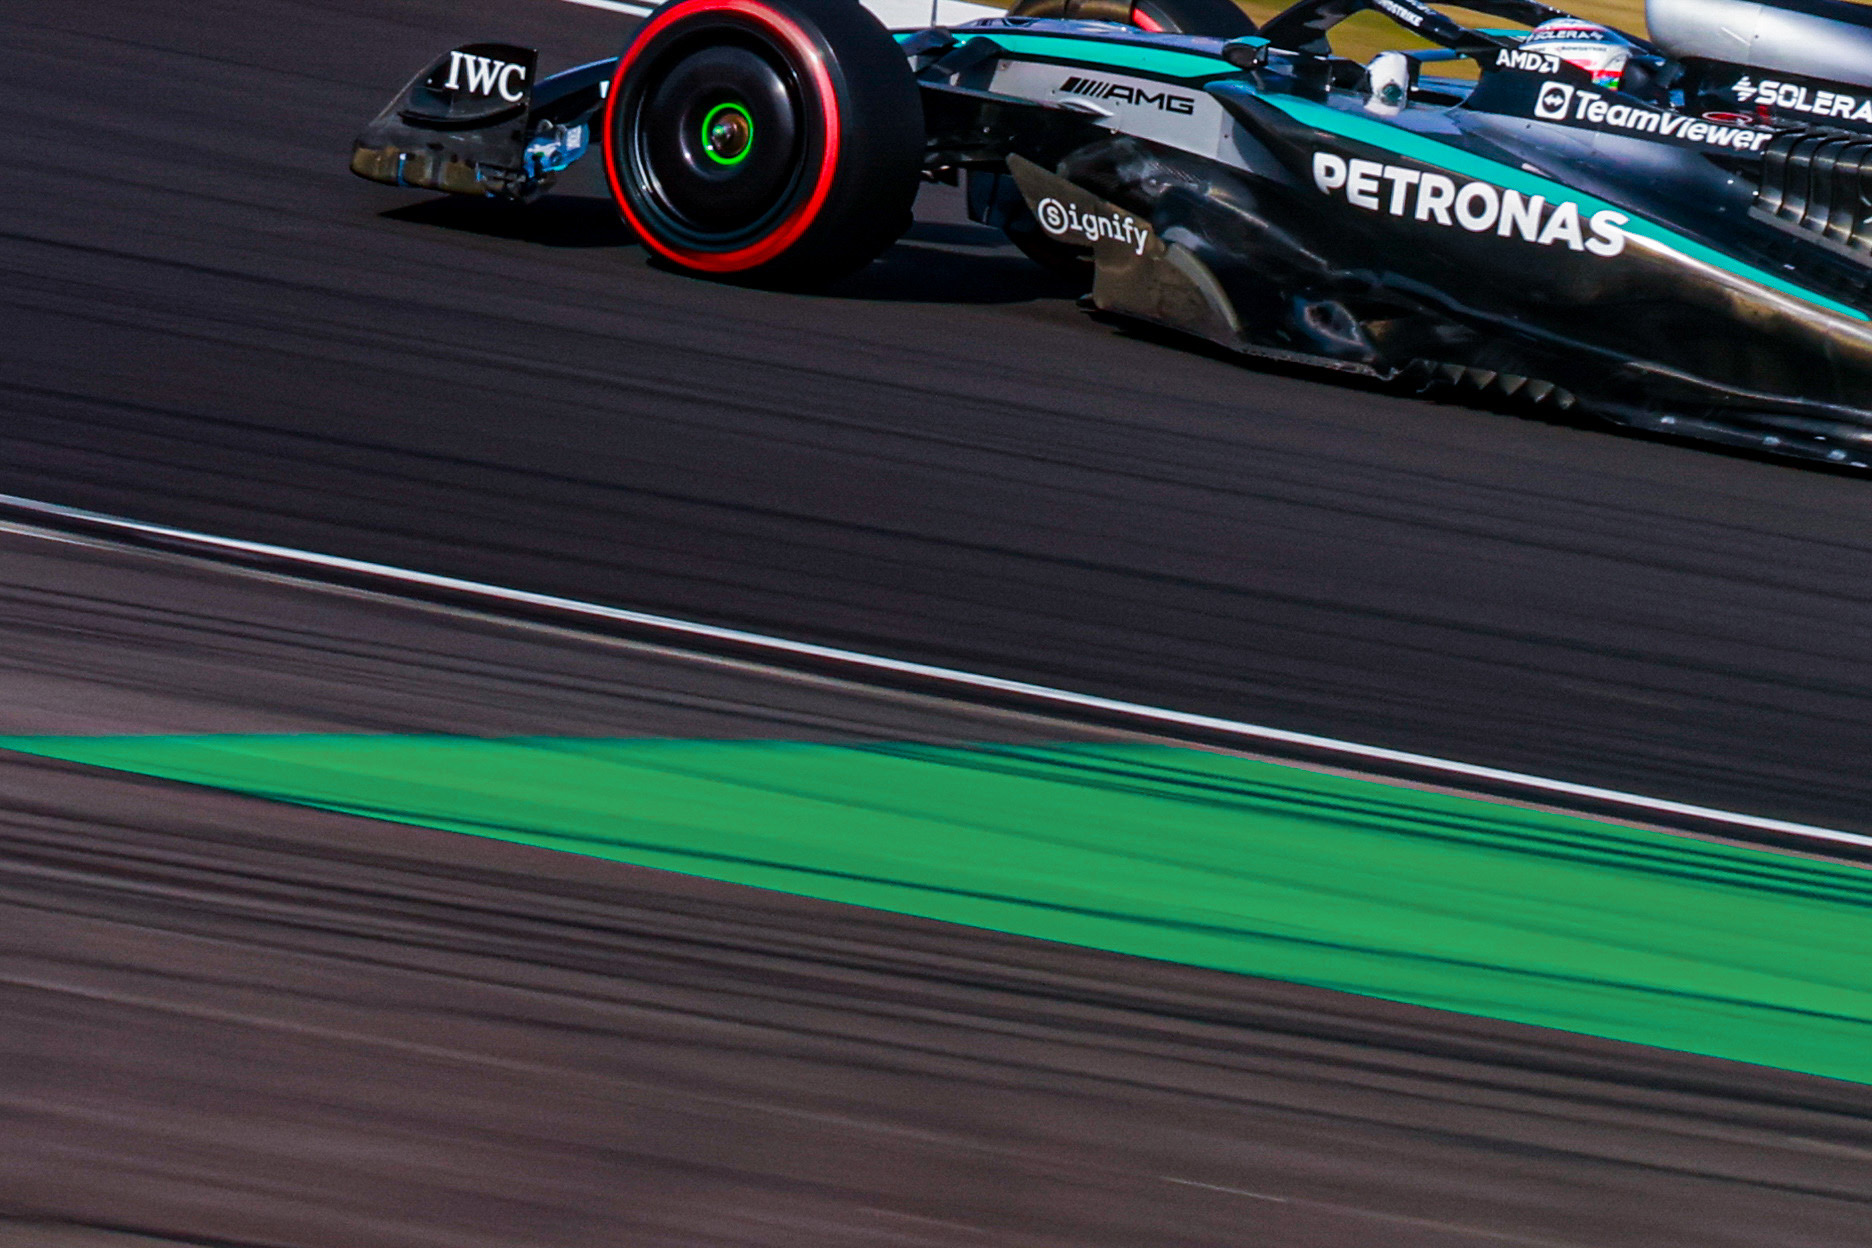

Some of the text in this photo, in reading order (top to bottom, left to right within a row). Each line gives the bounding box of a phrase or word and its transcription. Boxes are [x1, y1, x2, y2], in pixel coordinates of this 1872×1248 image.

[444, 52, 526, 102] IWC
[1496, 49, 1542, 71] AMD
[1102, 84, 1195, 116] AMG
[1575, 89, 1772, 152] TeamViewer
[1312, 152, 1629, 257] PETRONAS
